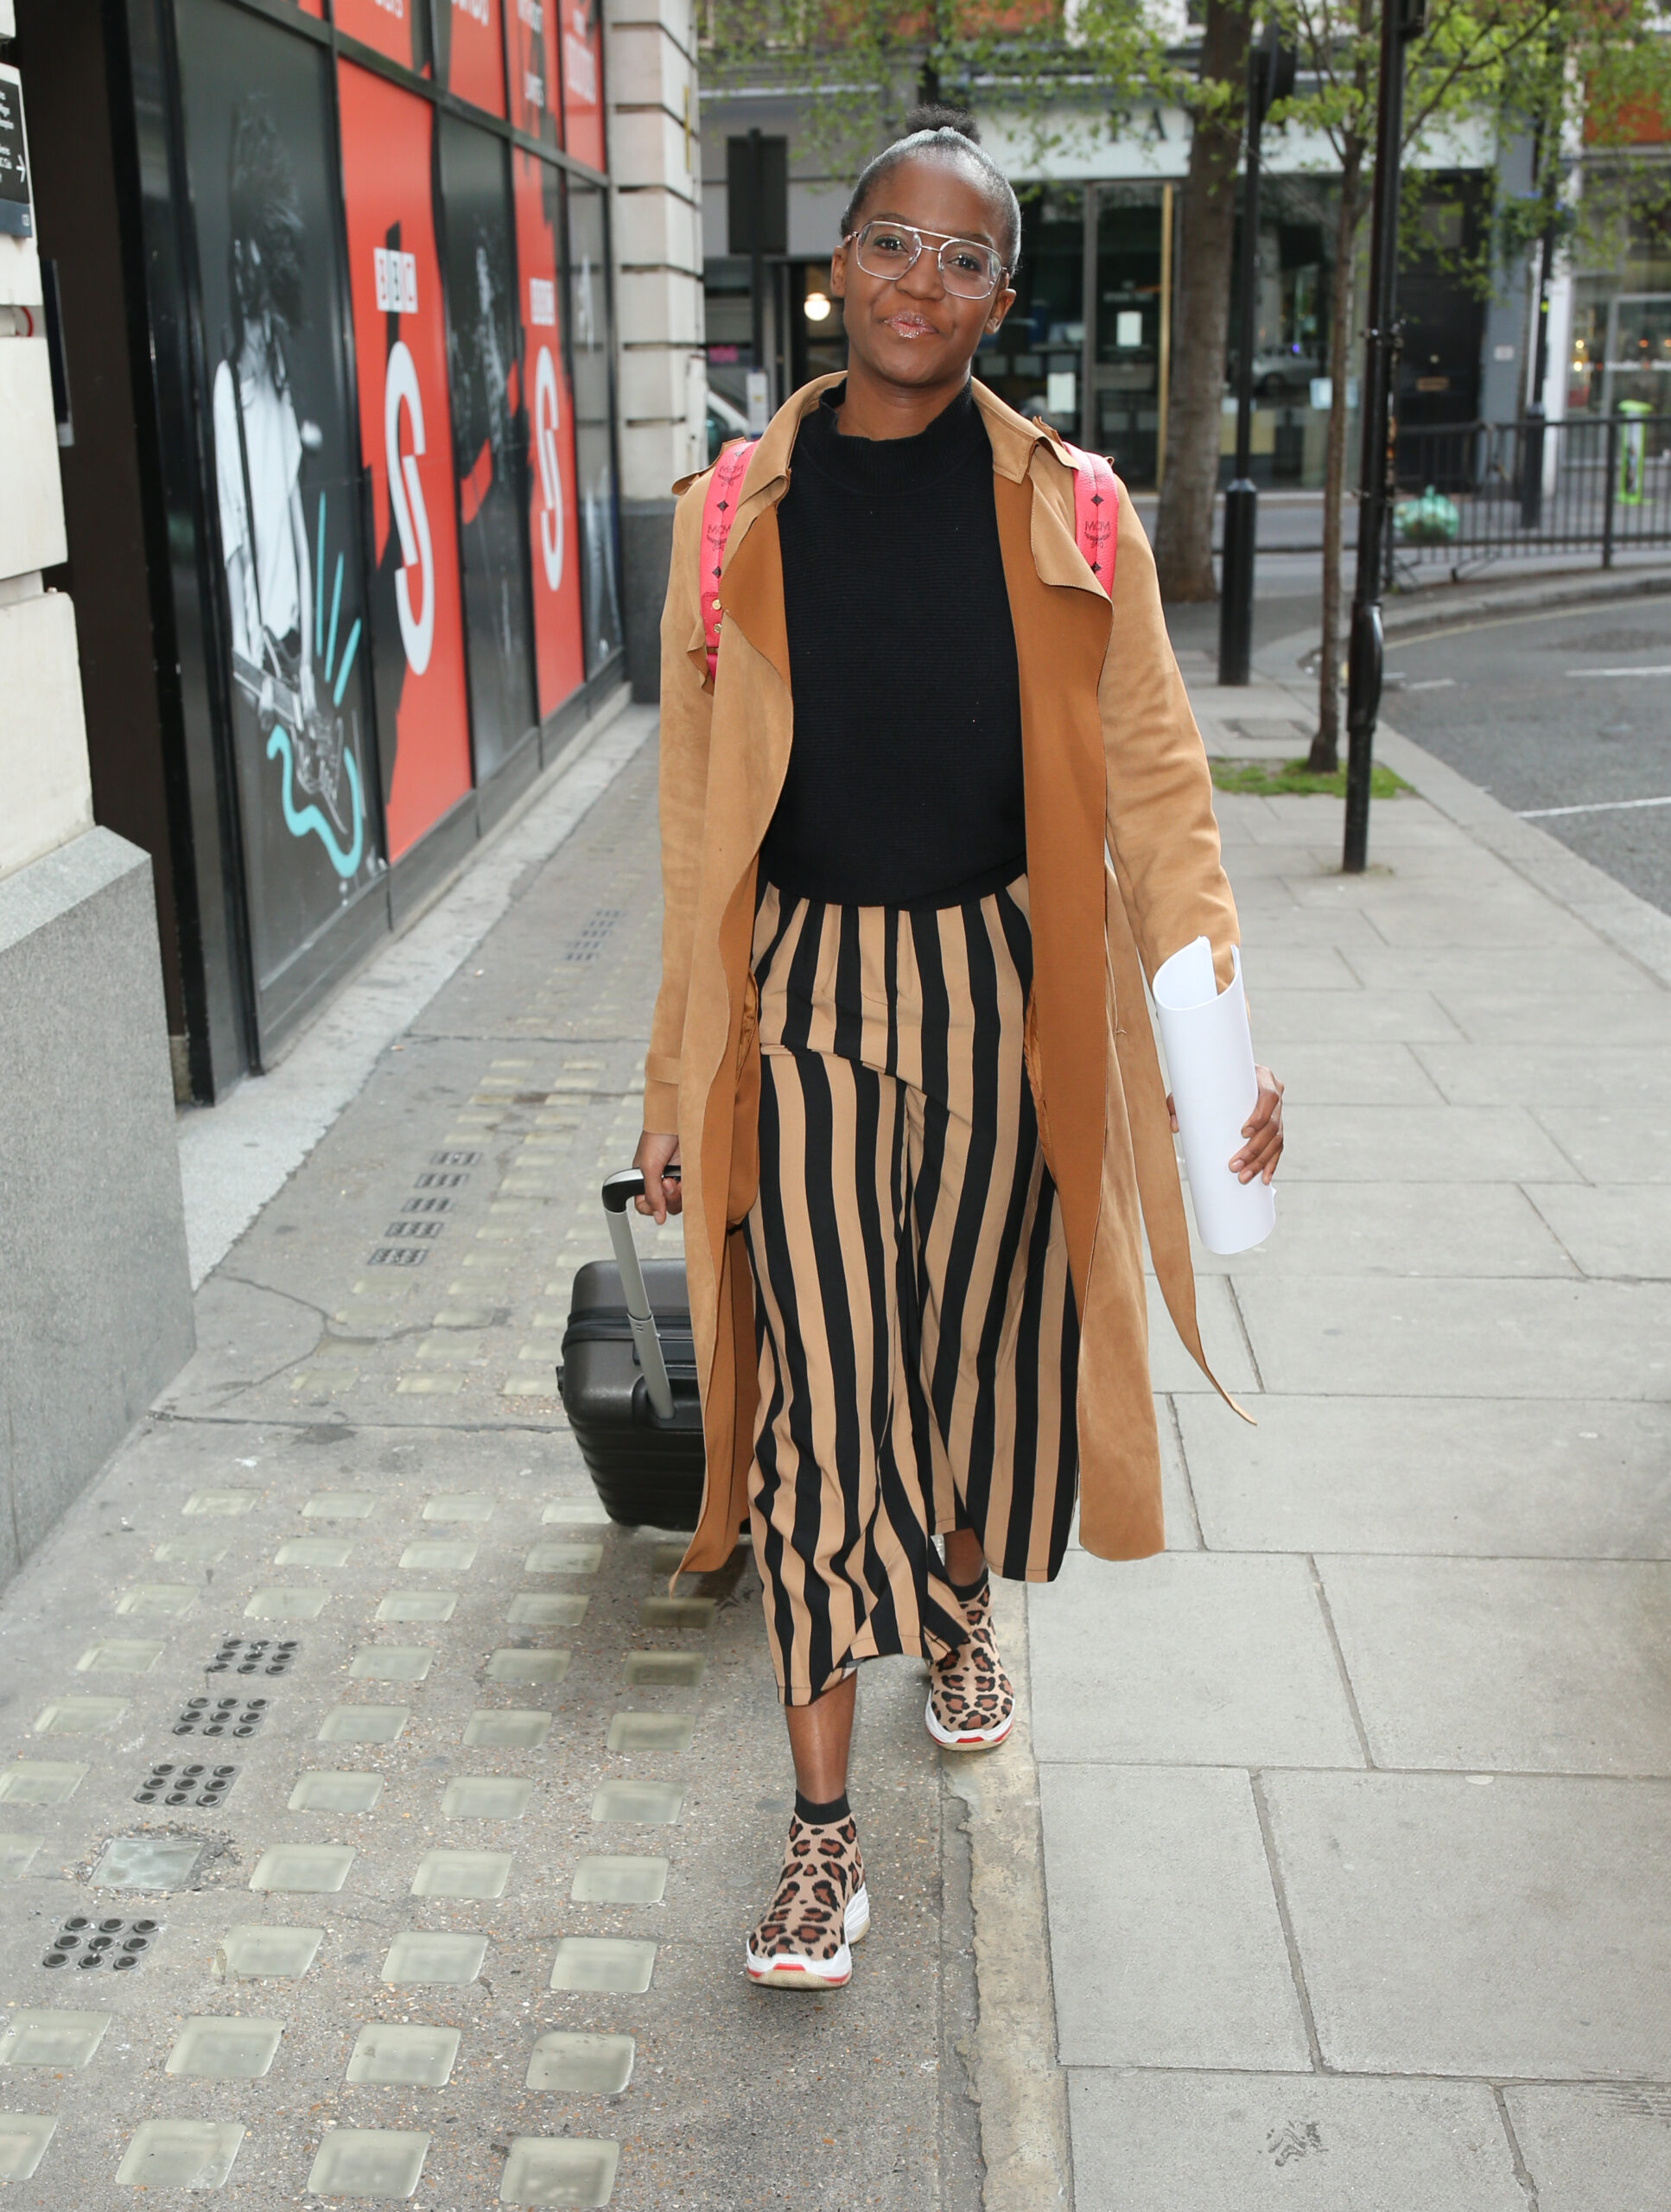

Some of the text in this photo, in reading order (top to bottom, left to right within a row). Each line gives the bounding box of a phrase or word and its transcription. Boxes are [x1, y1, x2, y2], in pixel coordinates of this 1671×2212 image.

[375, 250, 416, 311] BBC
[384, 340, 435, 676] S
[535, 345, 564, 592] S
[1085, 521, 1111, 531] MCM
